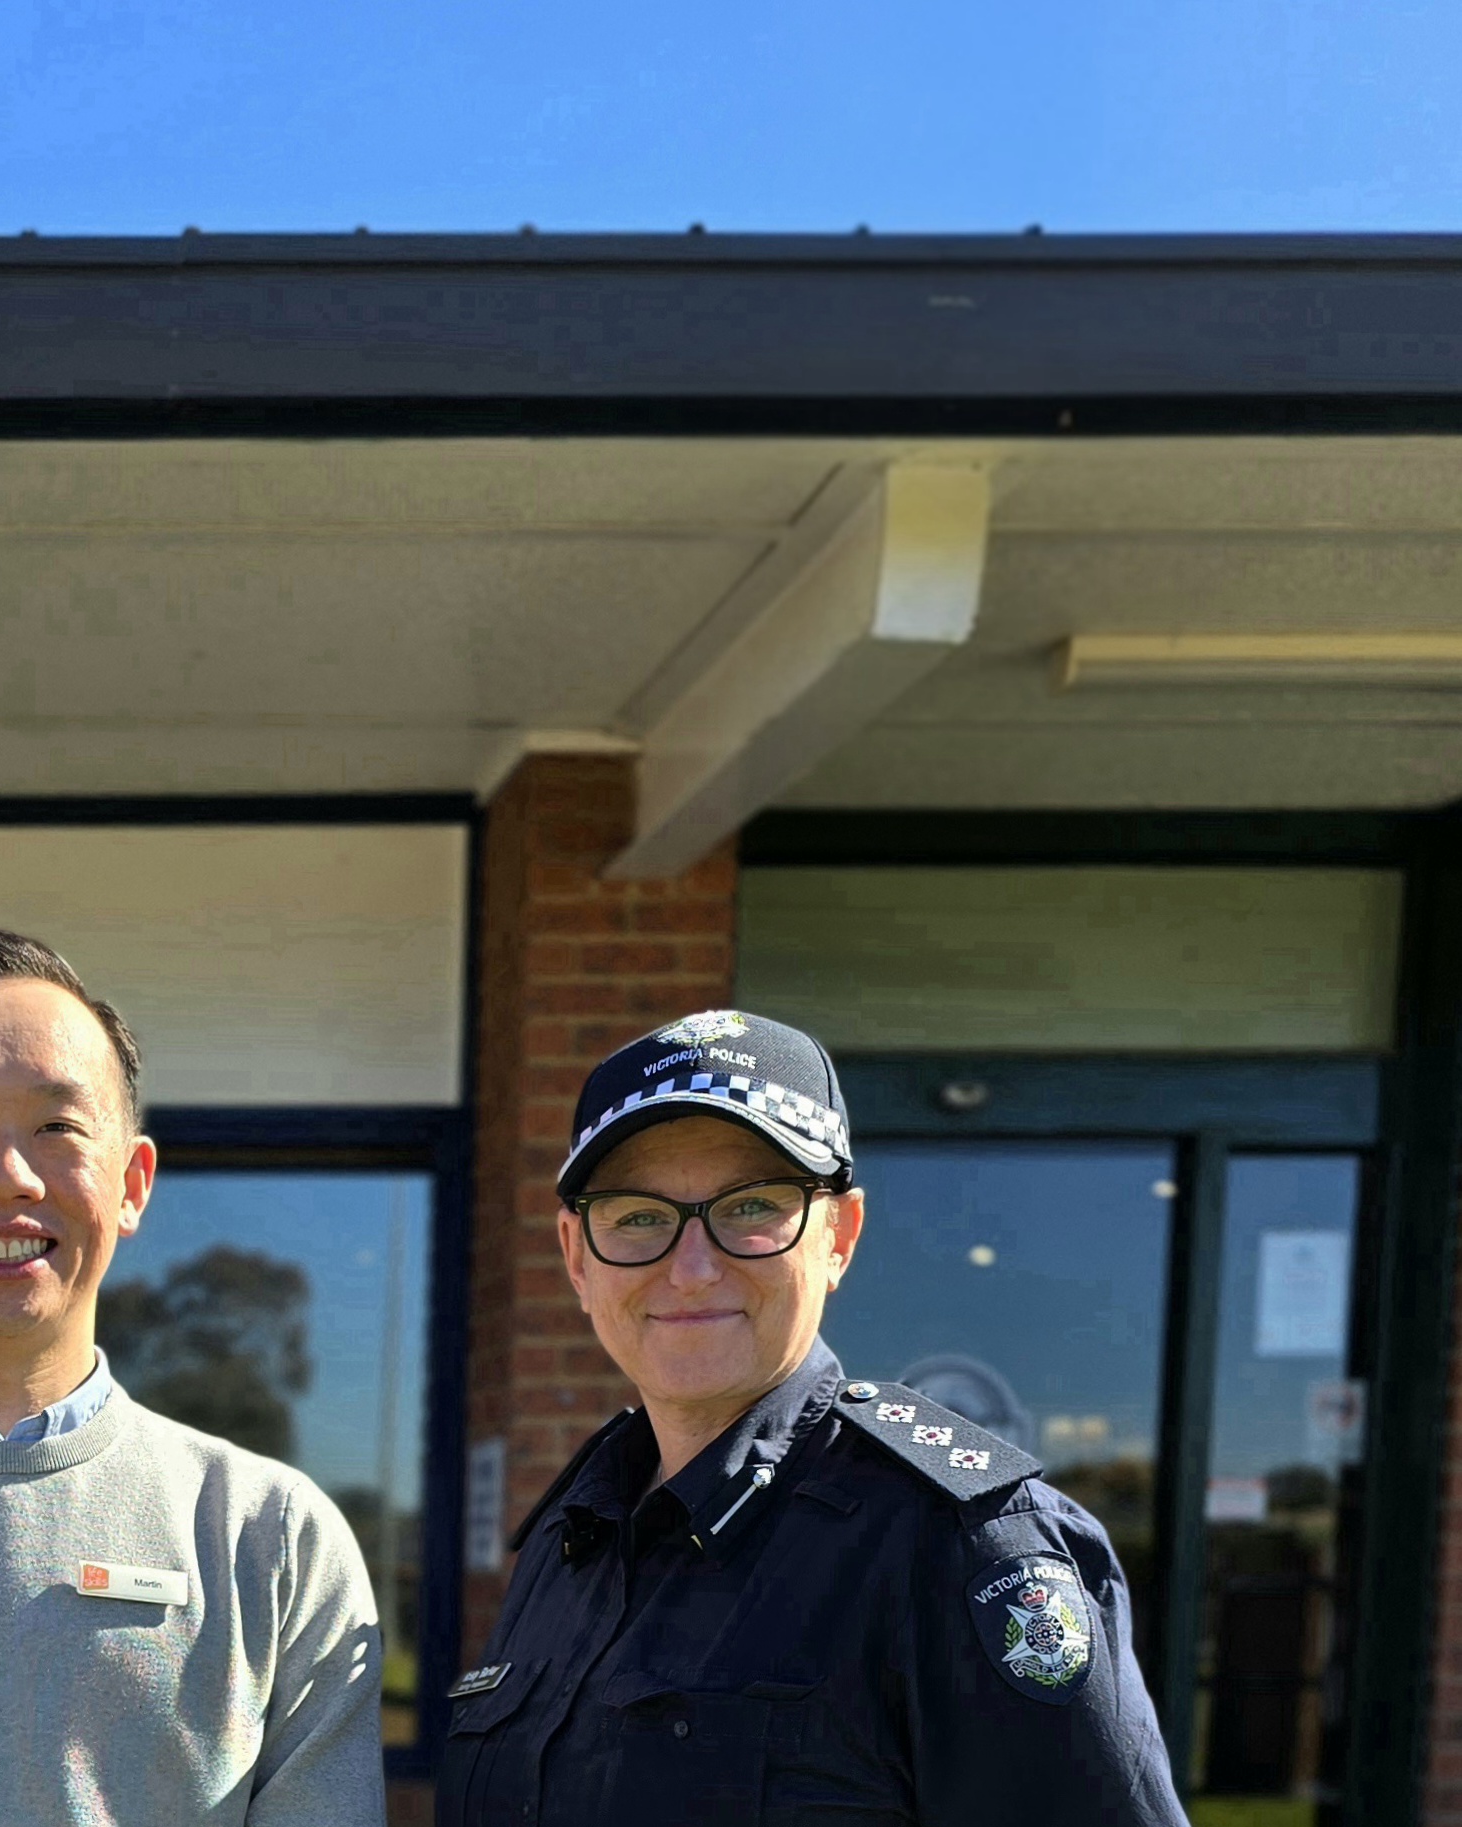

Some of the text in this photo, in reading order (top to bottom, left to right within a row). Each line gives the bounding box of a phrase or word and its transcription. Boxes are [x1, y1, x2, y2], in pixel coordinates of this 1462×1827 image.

[643, 1047, 757, 1077] VICTORIA POLICE
[134, 1578, 163, 1589] Martin
[974, 1566, 1033, 1604] VICTORIA
